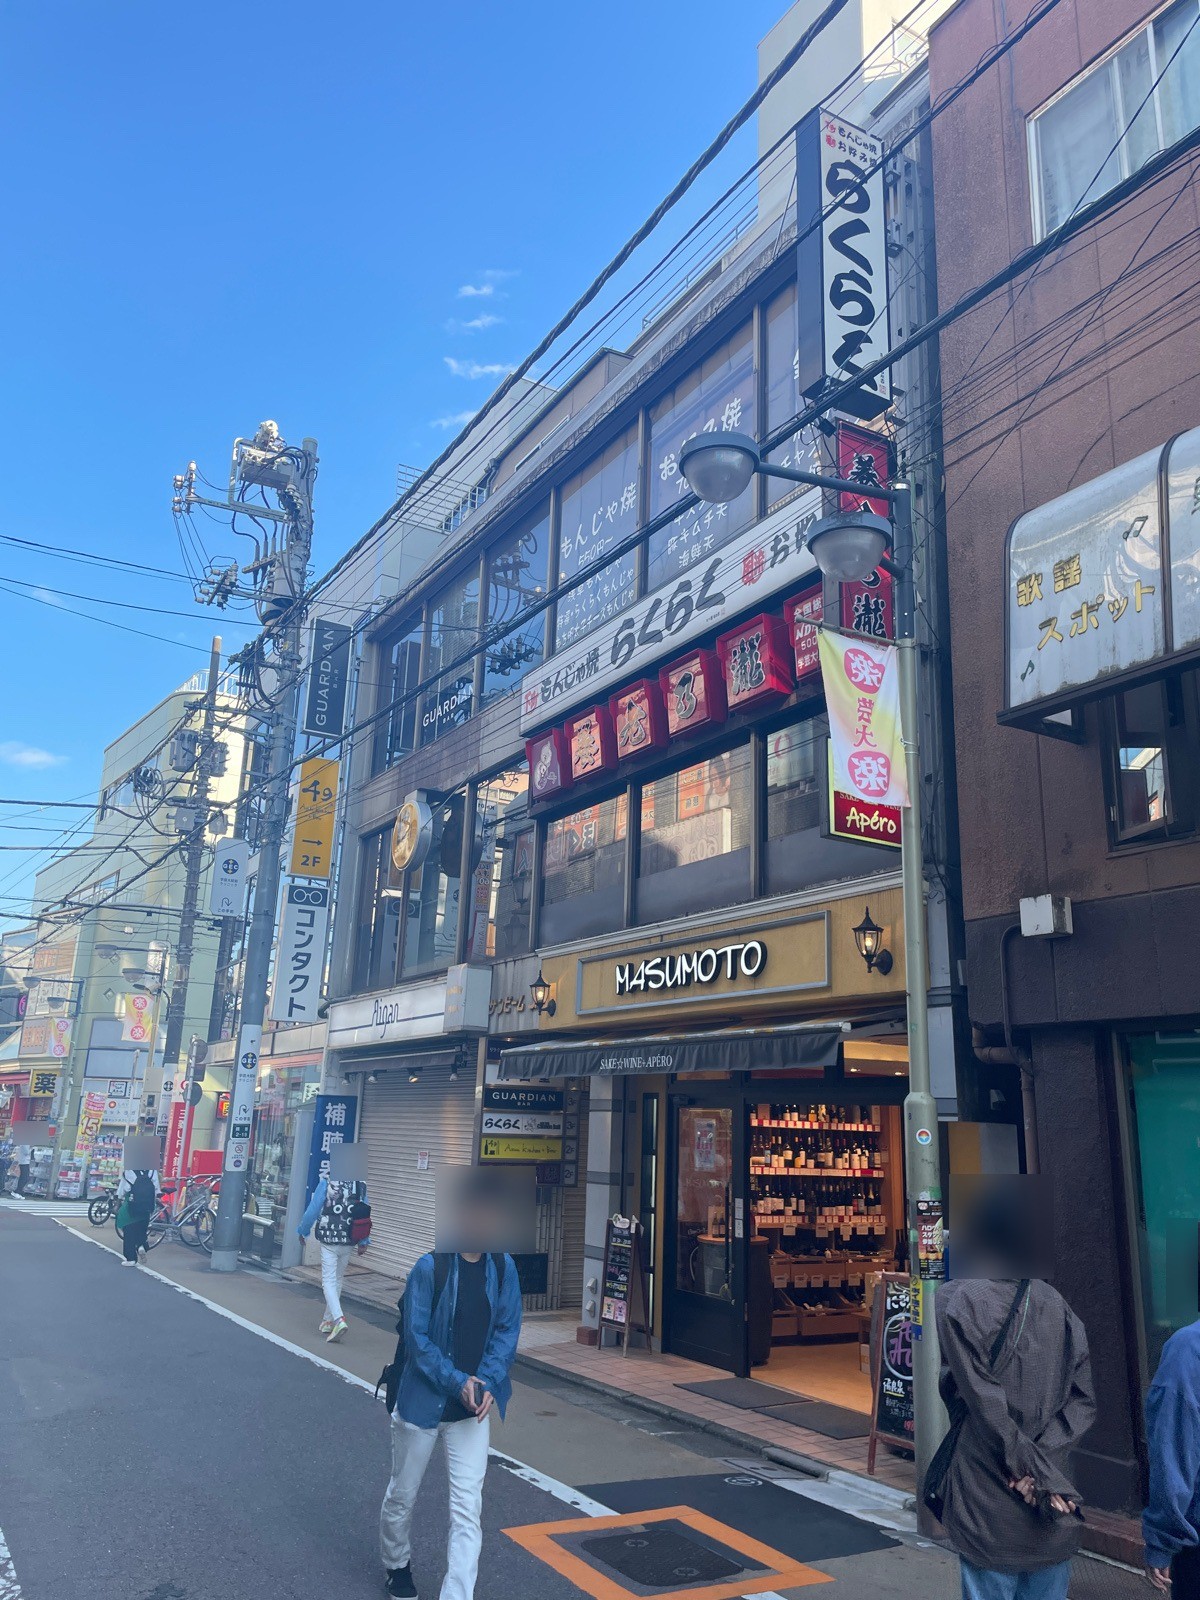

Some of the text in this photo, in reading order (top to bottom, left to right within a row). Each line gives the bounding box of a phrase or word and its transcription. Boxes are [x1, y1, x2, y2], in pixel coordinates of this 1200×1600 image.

[825, 159, 878, 392] らくらく
[560, 482, 637, 558] もんじゃ焼
[1017, 554, 1082, 607] 歌謡
[610, 557, 726, 670] らくらく
[1037, 579, 1156, 651] スポット
[315, 627, 335, 726] GUARDIAN
[846, 806, 897, 834] Apéro
[301, 854, 321, 867] 2F
[288, 908, 316, 1018] コンタクト
[616, 940, 766, 995] MASUMOTO
[34, 1073, 57, 1094] 薬
[492, 1091, 556, 1102] GUARDIAN
[484, 1118, 520, 1129] らくらく
